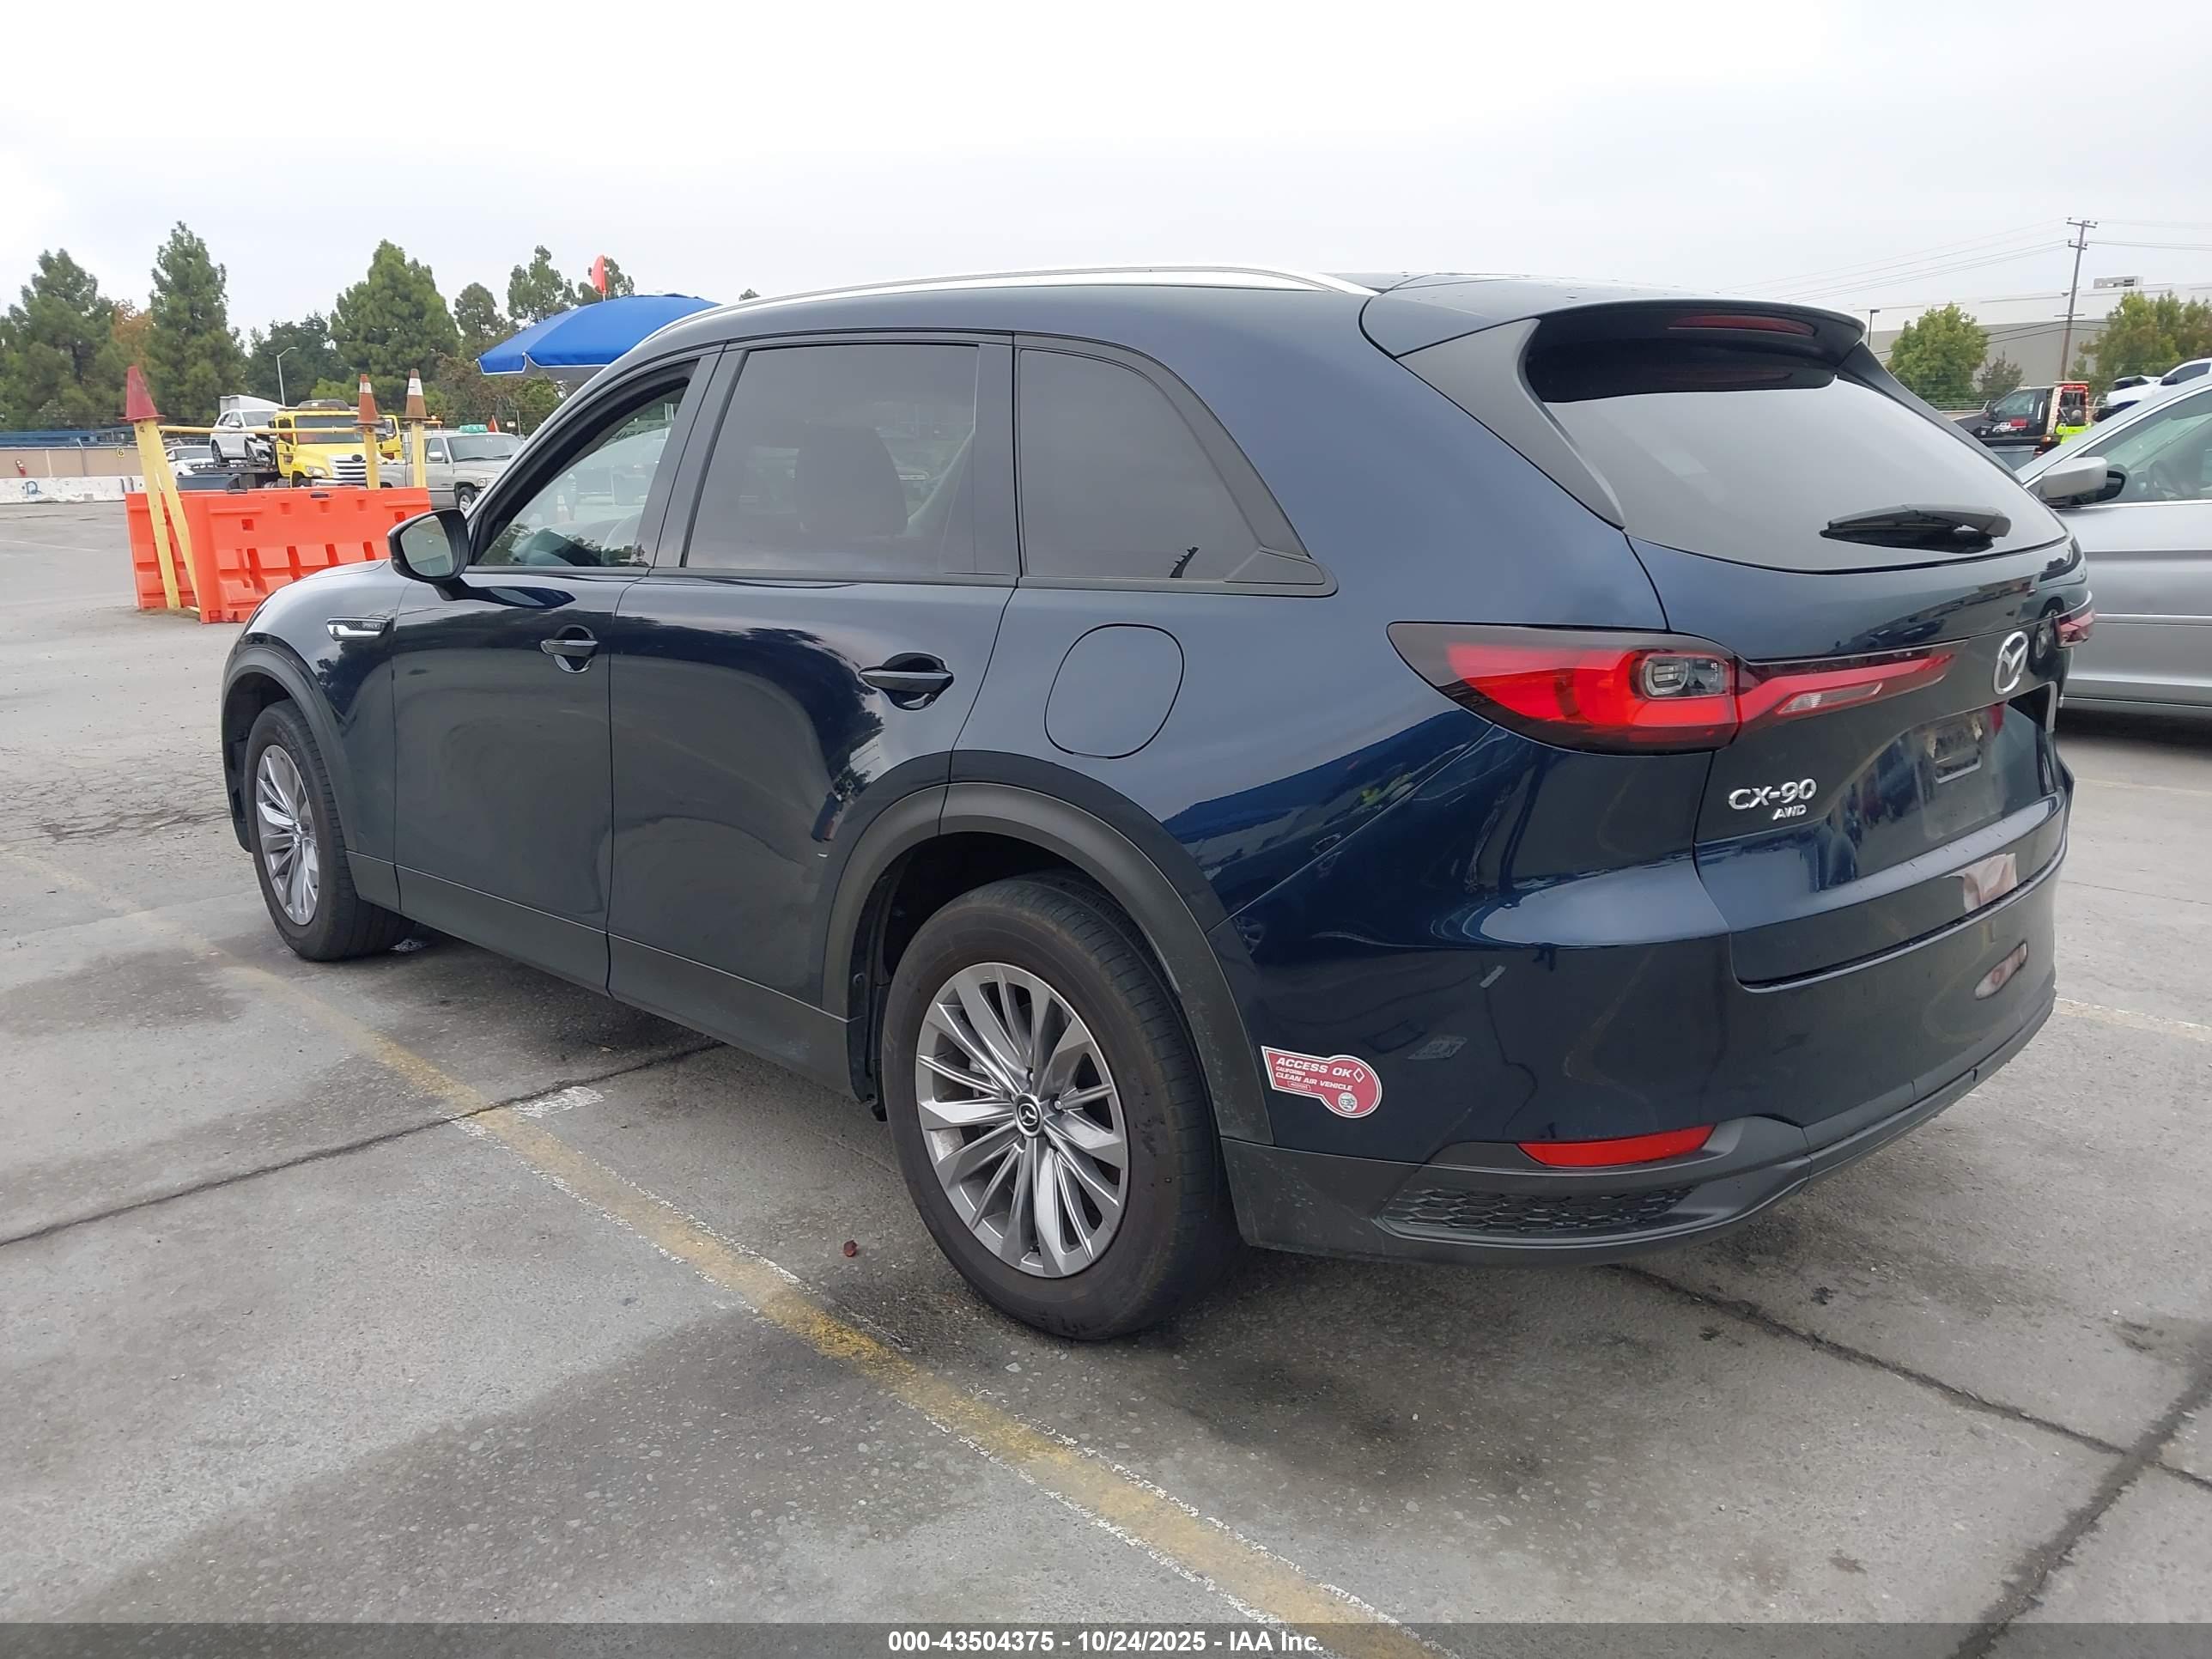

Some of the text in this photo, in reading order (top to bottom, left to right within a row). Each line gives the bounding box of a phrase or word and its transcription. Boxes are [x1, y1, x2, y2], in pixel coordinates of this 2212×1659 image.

[1729, 778, 1817, 810] CX-90
[1772, 804, 1807, 820] AWD
[1276, 1057, 1352, 1078] ACCESS OK
[1275, 1072, 1302, 1082] CLEAN
[1320, 1080, 1354, 1091] VEHICLE
